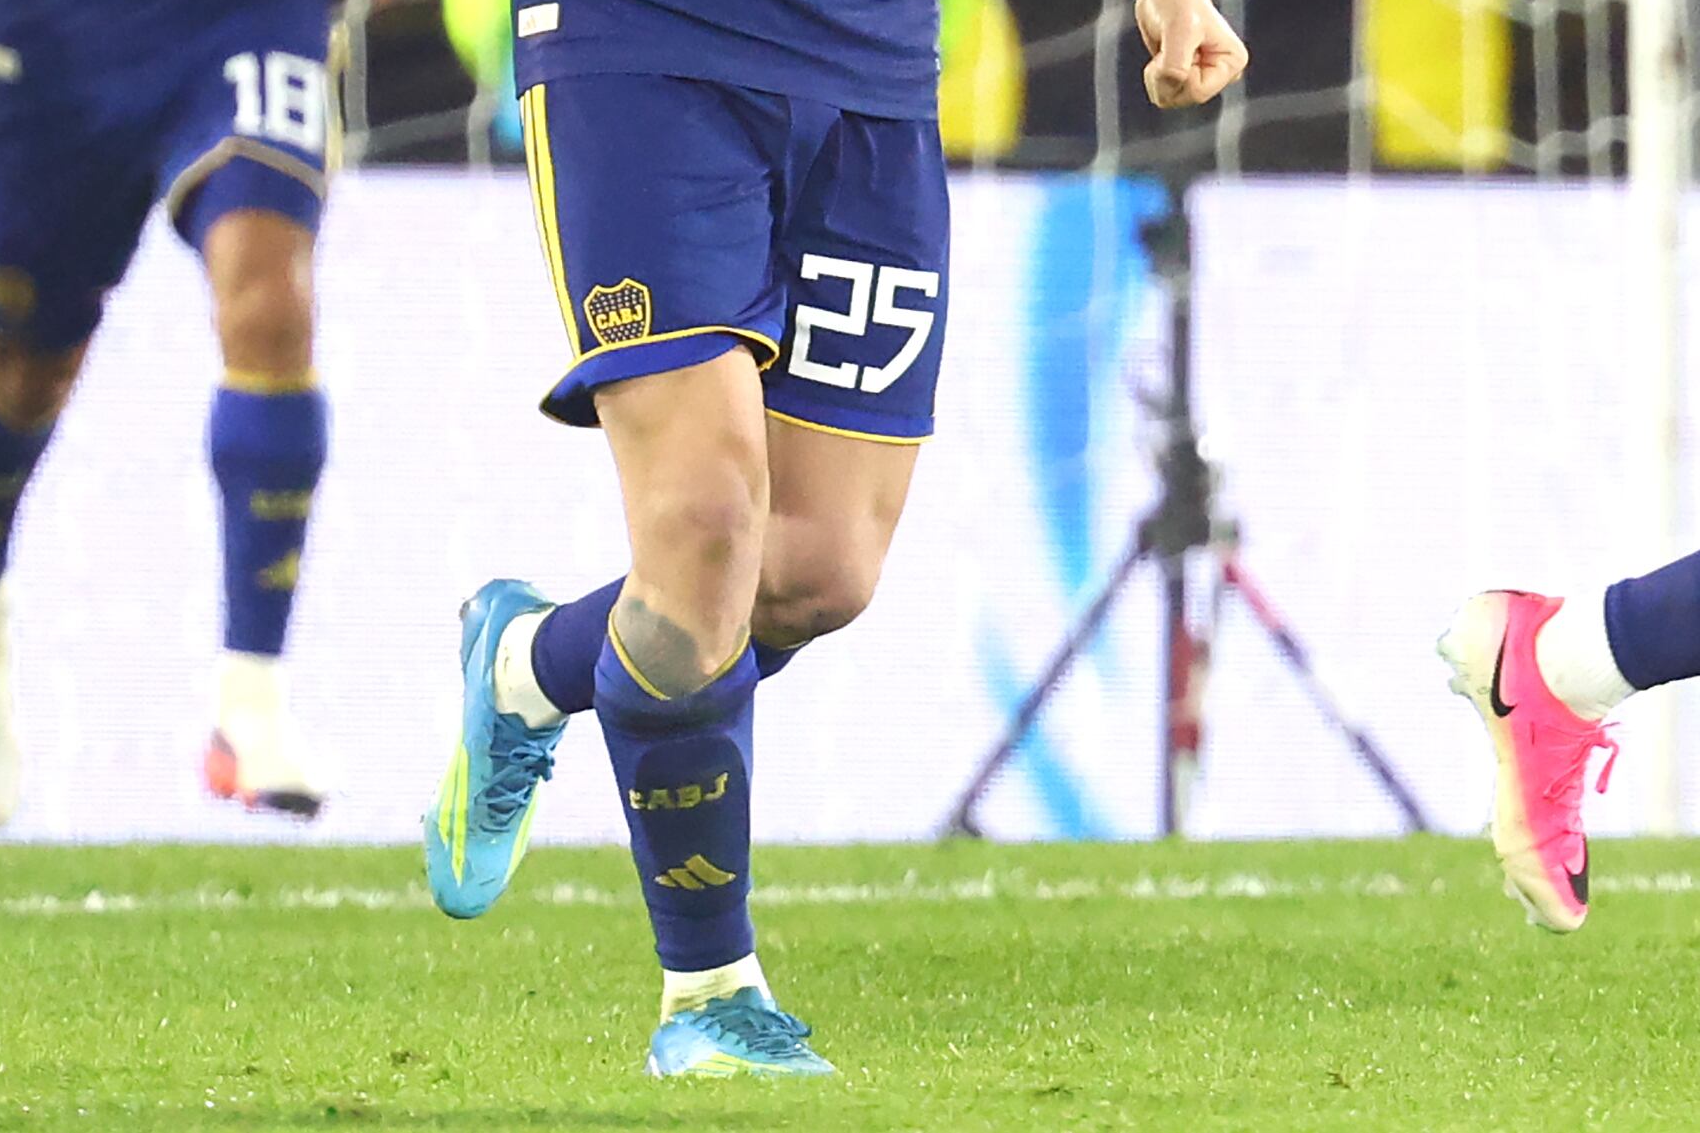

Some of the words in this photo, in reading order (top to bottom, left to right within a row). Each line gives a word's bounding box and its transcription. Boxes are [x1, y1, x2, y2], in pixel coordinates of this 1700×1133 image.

[222, 50, 328, 152] 18
[595, 304, 644, 330] CABJ
[787, 252, 940, 394] 25
[628, 771, 729, 810] CABJ
